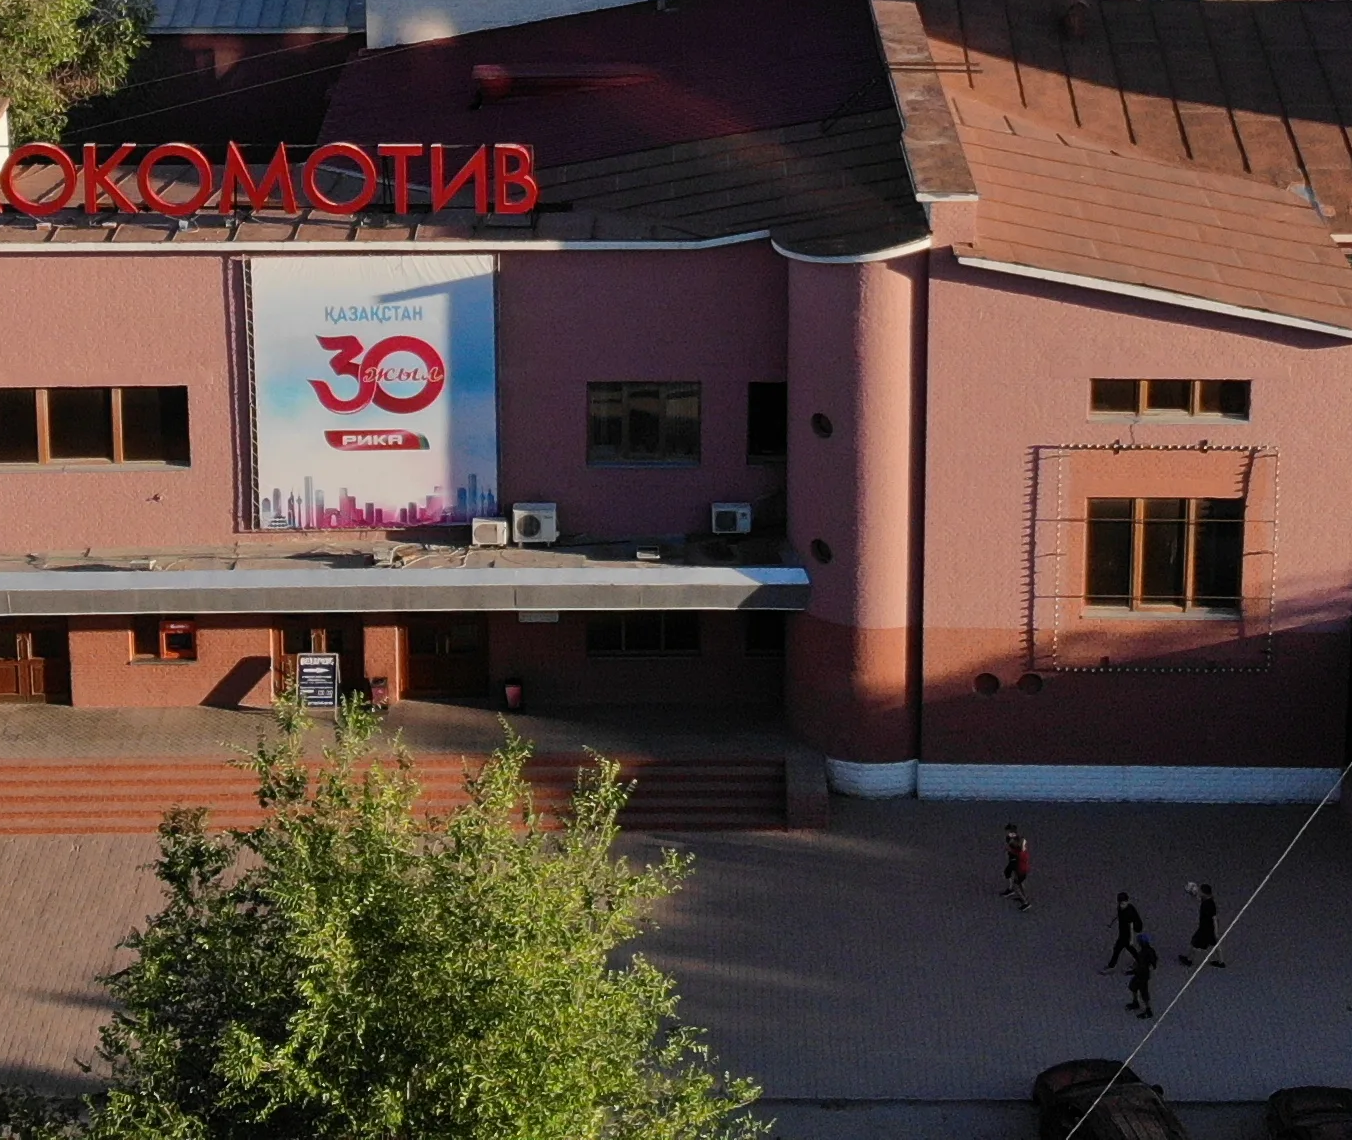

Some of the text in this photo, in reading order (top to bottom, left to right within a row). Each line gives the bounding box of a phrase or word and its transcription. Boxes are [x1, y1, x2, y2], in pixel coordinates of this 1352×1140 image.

[324, 305, 423, 325] ҚАЗАҚСТАН
[308, 334, 445, 415] 30
[342, 434, 404, 446] РИКА
